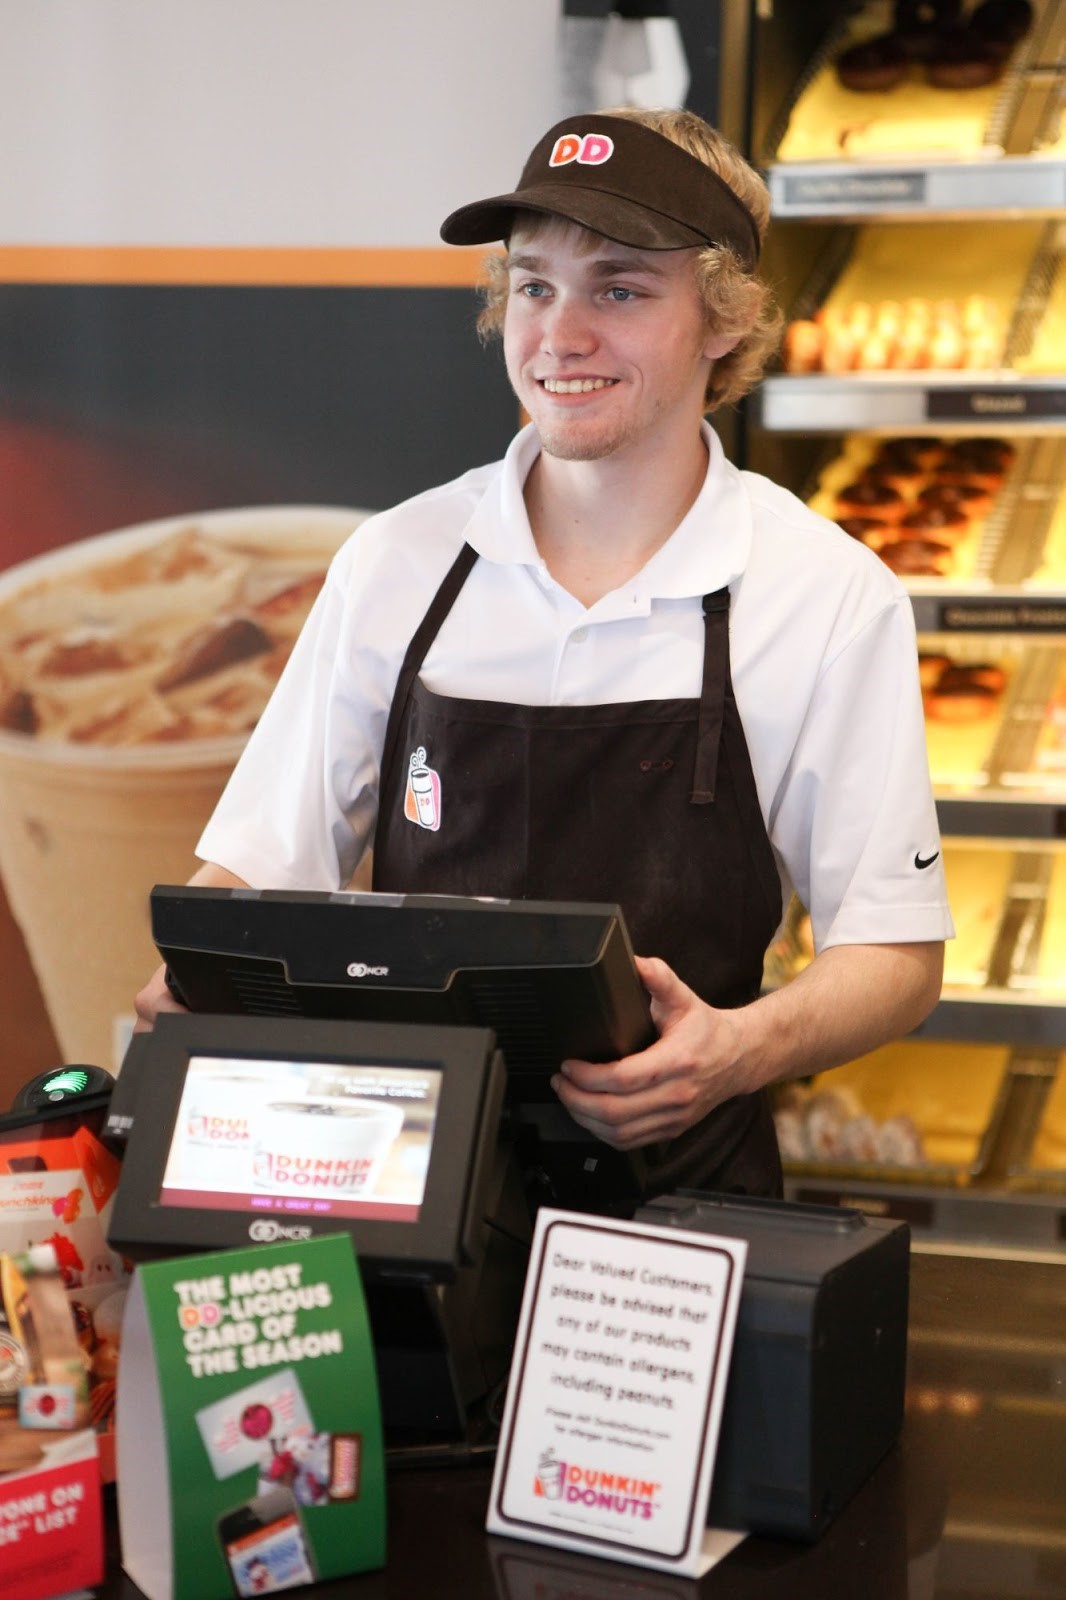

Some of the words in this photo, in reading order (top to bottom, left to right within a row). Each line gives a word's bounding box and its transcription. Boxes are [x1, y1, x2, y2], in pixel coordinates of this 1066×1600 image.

[550, 134, 613, 166] DD
[366, 966, 389, 976] NCR
[274, 1170, 367, 1187] DONUTS
[277, 1226, 313, 1241] NCR
[552, 1253, 585, 1271] Dear
[590, 1260, 636, 1281] Valued
[174, 1275, 226, 1303] THE
[229, 1263, 302, 1297] MOST
[550, 1283, 595, 1301] please
[599, 1291, 616, 1306] be
[622, 1298, 674, 1318] advised
[679, 1307, 708, 1324] that
[183, 1321, 257, 1354] CARD
[261, 1313, 296, 1341] OF
[556, 1316, 581, 1333] any
[585, 1320, 600, 1334] of
[604, 1325, 626, 1338] our
[631, 1330, 691, 1352] products
[186, 1347, 238, 1379] THE
[241, 1329, 343, 1369] SEASON
[542, 1341, 569, 1359] may
[574, 1347, 624, 1367] contain
[551, 1373, 613, 1400] including
[51, 1483, 84, 1508] ON
[567, 1486, 653, 1520] DONUTS
[35, 1505, 77, 1535] LIST
